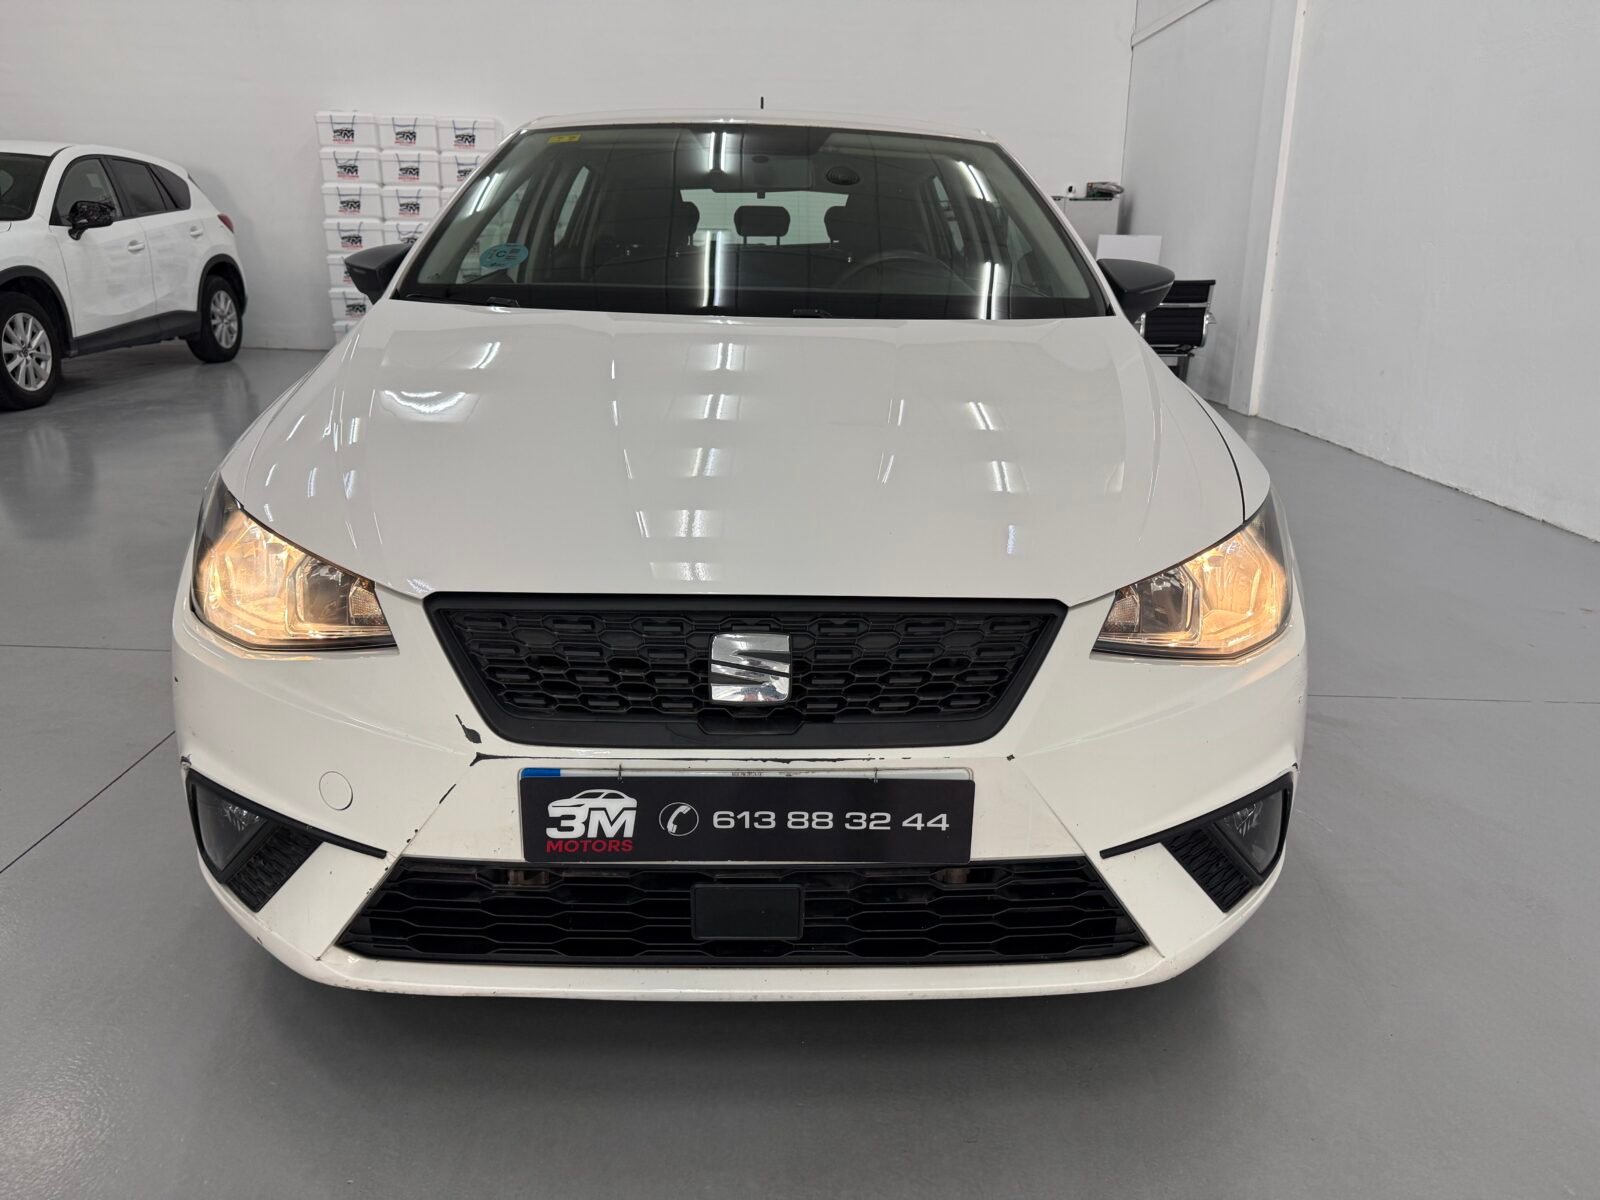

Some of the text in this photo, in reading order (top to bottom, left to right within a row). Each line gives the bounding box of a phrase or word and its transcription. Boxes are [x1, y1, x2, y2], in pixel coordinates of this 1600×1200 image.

[546, 805, 636, 839] 3M
[712, 810, 950, 832] 613 88 32 44
[546, 839, 633, 853] MOTORS
